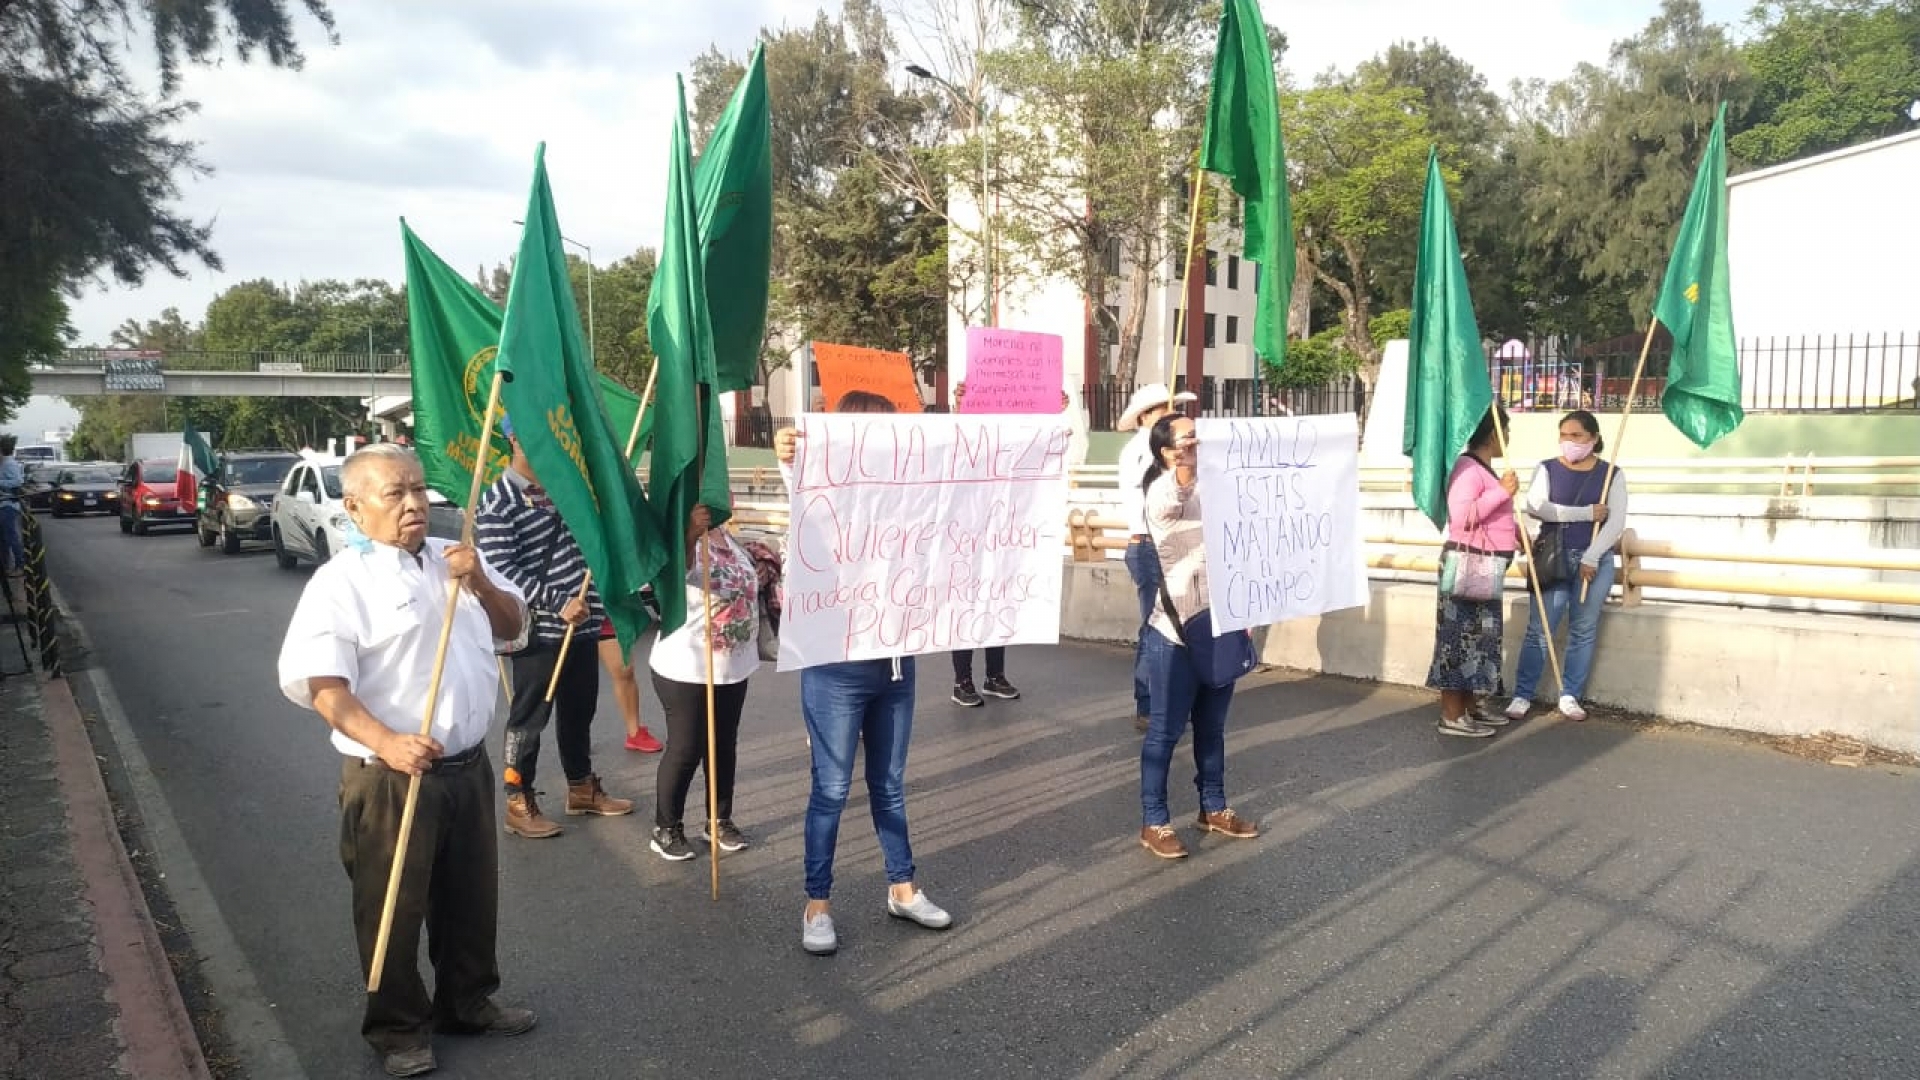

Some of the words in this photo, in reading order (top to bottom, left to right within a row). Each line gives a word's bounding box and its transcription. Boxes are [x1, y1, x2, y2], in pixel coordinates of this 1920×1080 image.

[797, 417, 925, 489] LUCIA
[951, 422, 1066, 479] MEZA
[1226, 420, 1317, 468] AMLO
[1236, 473, 1305, 517] ESTAS
[1223, 513, 1332, 562] MATANDO
[788, 575, 878, 624] nadora
[1227, 571, 1315, 619] CAMPO
